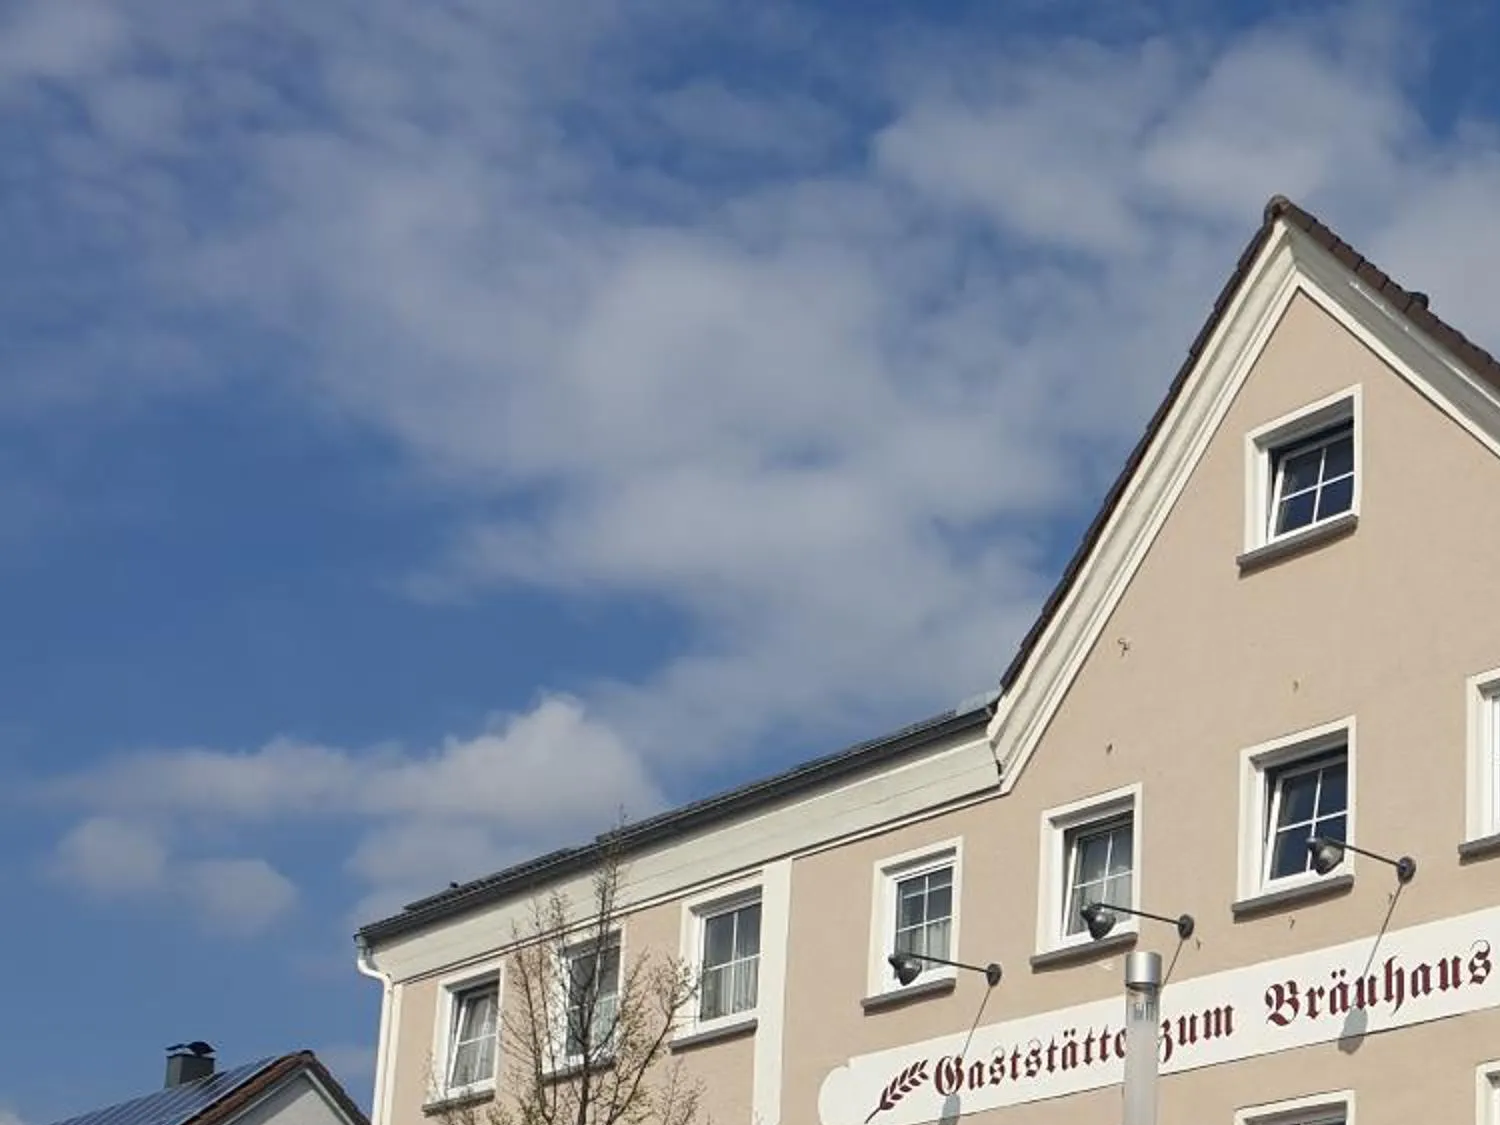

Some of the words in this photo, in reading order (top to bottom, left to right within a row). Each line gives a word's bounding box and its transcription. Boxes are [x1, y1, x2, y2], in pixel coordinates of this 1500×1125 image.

[934, 1023, 1127, 1097] Gaststätte
[1159, 1001, 1236, 1065] zum
[1264, 939, 1493, 1027] Bräuhaus
